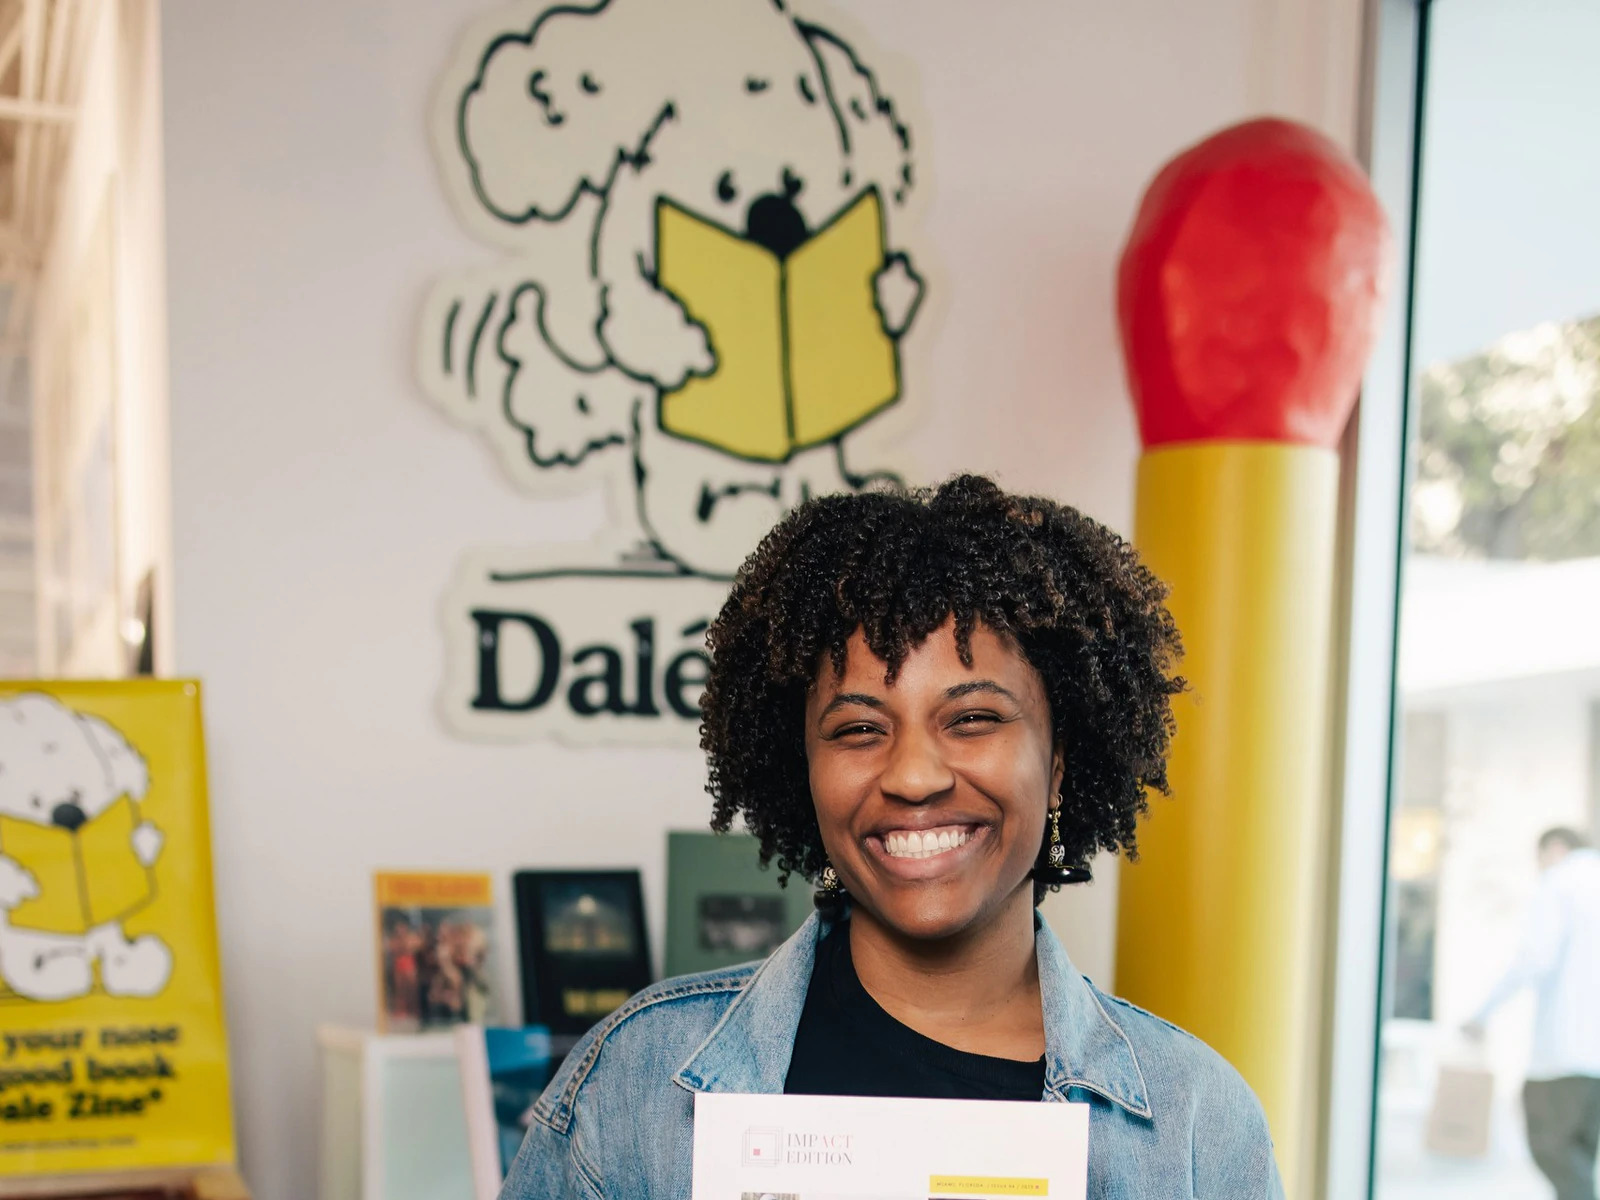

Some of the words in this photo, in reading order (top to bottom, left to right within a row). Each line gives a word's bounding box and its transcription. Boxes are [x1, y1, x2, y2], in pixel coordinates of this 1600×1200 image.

[468, 609, 712, 719] Dalé
[5, 1031, 83, 1056] your
[101, 1027, 178, 1046] nose
[87, 1054, 175, 1080] book
[0, 1096, 52, 1121] ale
[786, 1133, 854, 1149] IMPACT
[786, 1150, 852, 1165] EDITION
